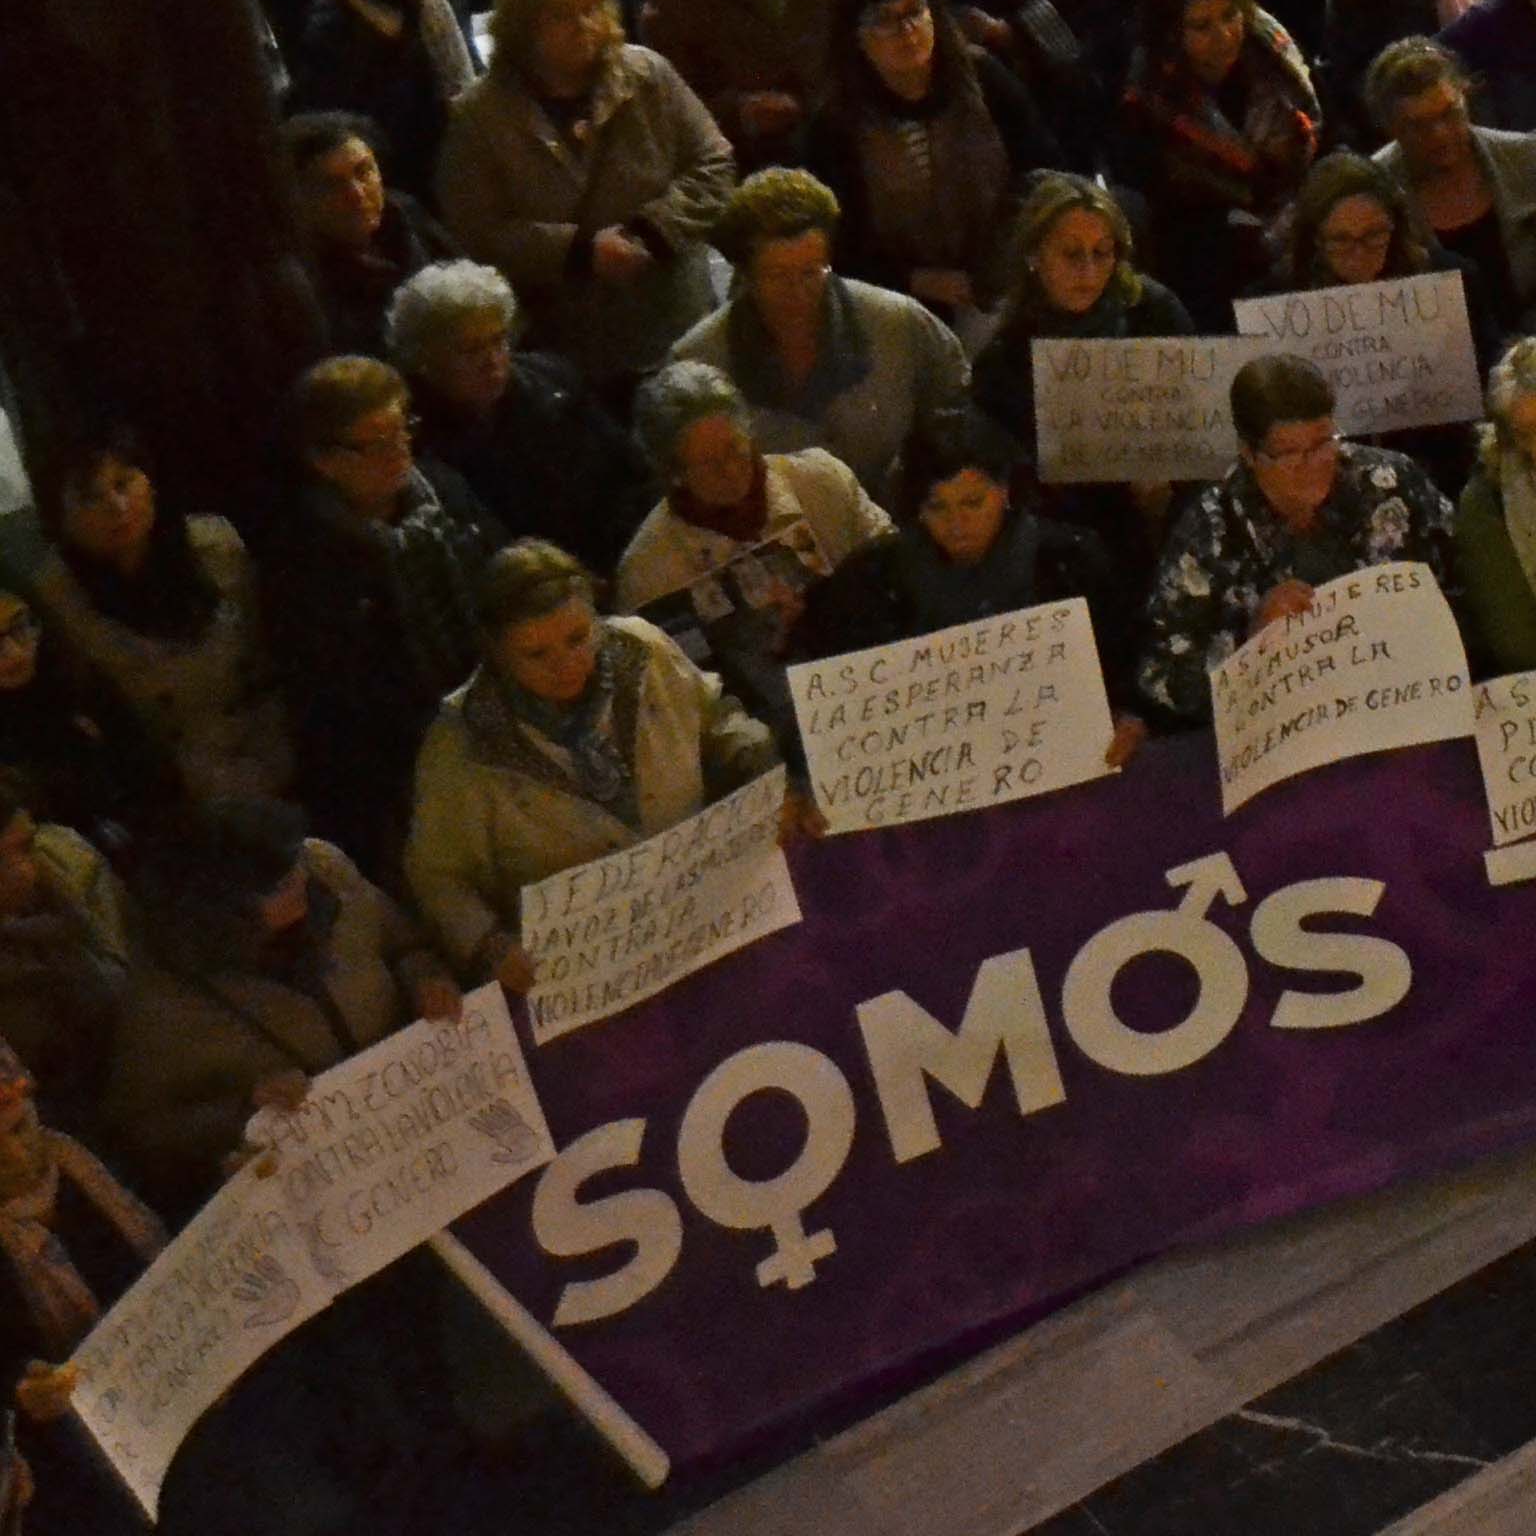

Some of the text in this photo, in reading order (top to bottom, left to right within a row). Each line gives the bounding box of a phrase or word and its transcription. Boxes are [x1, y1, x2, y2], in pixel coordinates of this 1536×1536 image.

[1260, 286, 1445, 341] VO DE MU
[1047, 344, 1092, 382] VO
[1156, 347, 1218, 381] MU
[1311, 336, 1391, 359] CONTRA
[1285, 571, 1422, 637] MUJERES
[909, 607, 1072, 674] MUJERES
[1350, 639, 1392, 667] LA
[808, 641, 1068, 736] LA ESPERANZA
[1363, 673, 1462, 711] GENERO
[835, 683, 1060, 763] CONTRA LA
[819, 719, 1048, 808] VIOLENCIA DE
[864, 757, 1044, 825] GENERO
[534, 918, 659, 984] CONTRA
[532, 852, 1412, 1327] SOMOS
